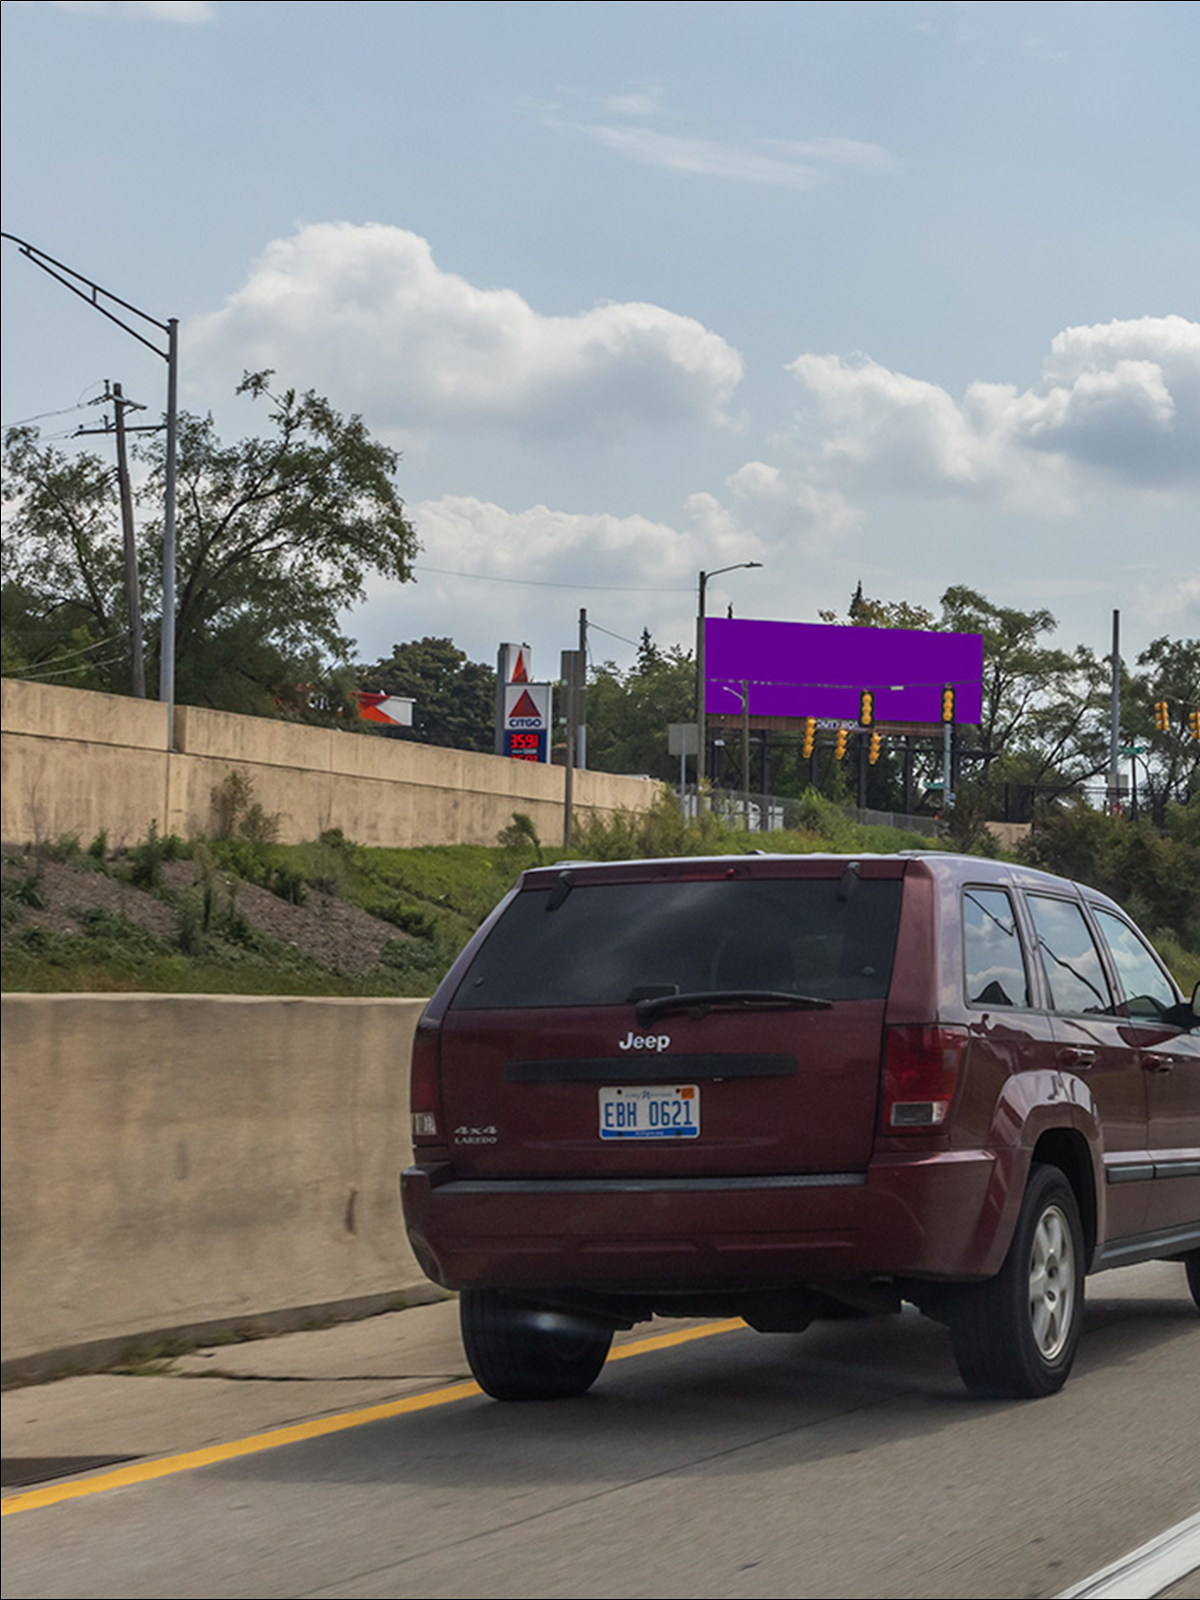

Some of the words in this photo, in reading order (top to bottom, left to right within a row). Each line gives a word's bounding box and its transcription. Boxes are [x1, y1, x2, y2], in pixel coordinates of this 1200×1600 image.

[509, 718, 541, 728] CITGO
[618, 1032, 671, 1052] Jeep
[604, 1101, 637, 1128] EBH
[649, 1100, 693, 1127] 0621
[453, 1125, 498, 1136] 4x4
